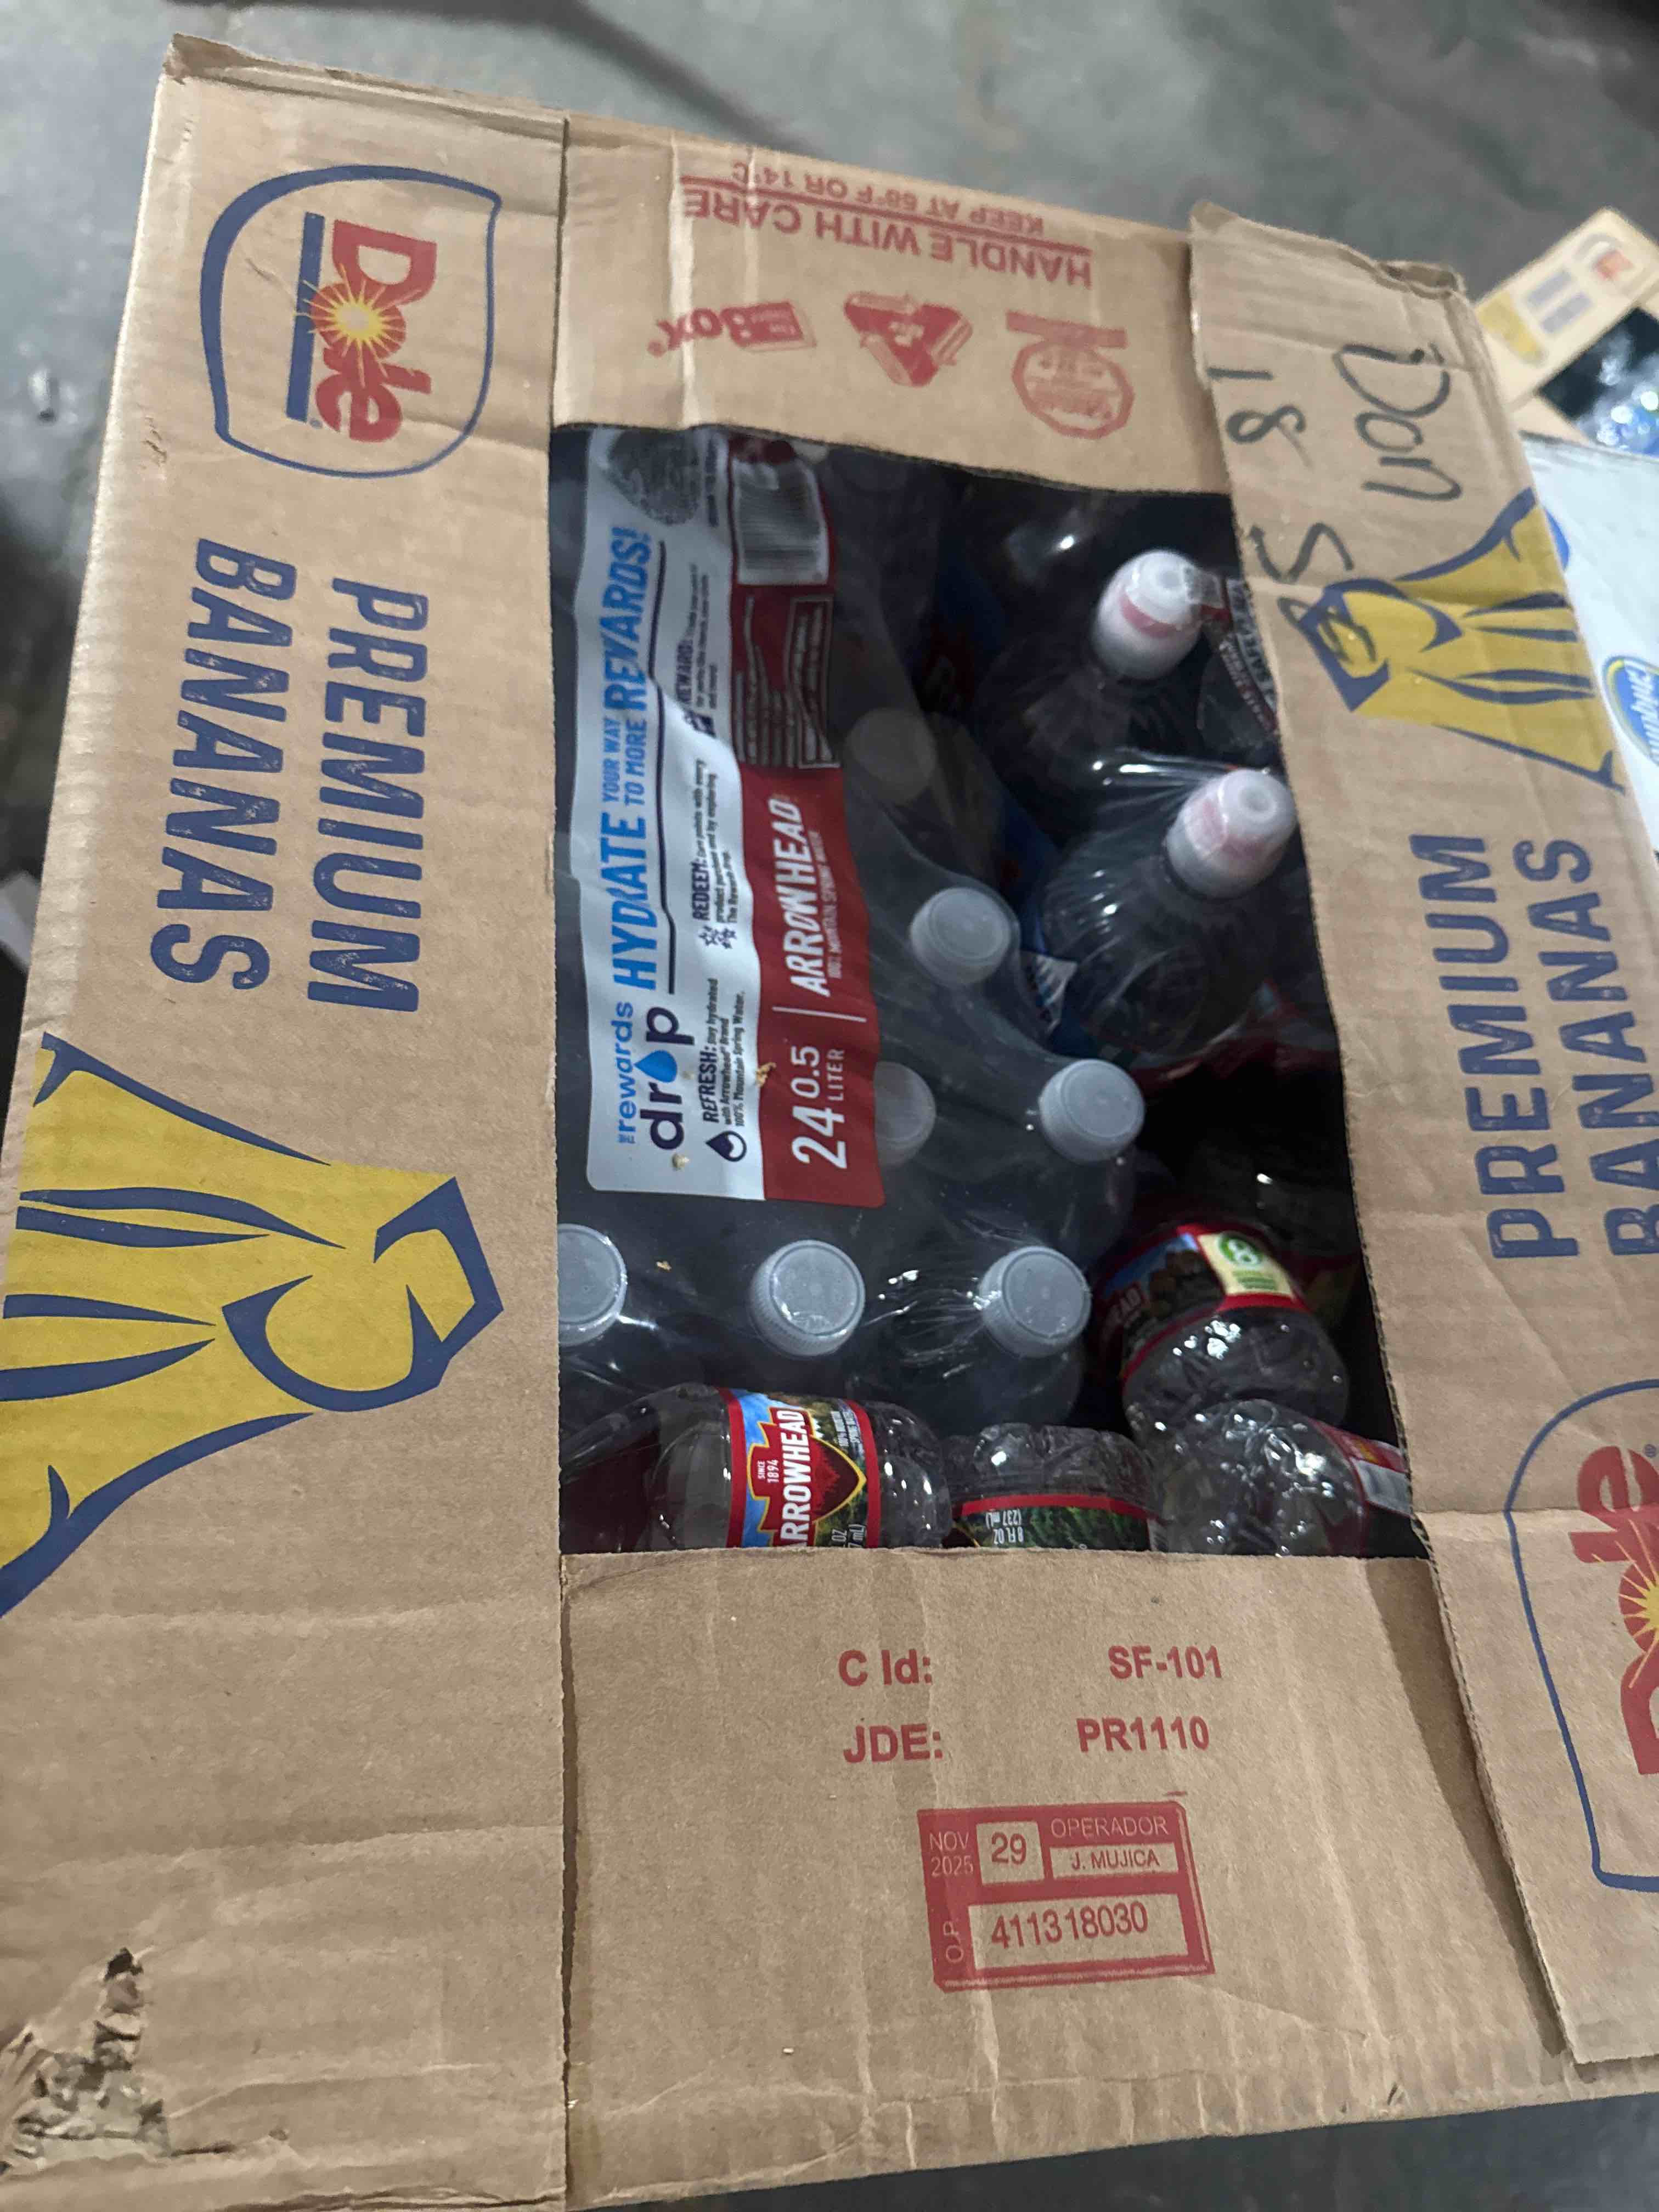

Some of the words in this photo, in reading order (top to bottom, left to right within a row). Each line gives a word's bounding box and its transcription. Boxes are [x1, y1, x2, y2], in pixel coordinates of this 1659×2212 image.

[803, 173, 848, 198] OR
[684, 189, 802, 234] CARE
[926, 195, 960, 219] AT
[816, 211, 921, 256] WITH
[928, 230, 1092, 290] HANDLE
[314, 219, 438, 443] Dole
[603, 716, 621, 753] WAY
[625, 719, 647, 777] MORE
[150, 538, 297, 990] BANANAS
[603, 758, 620, 802] YOUR
[307, 578, 429, 1012] PREMIUM
[624, 782, 645, 806] TO
[691, 857, 710, 921] REDEEM:
[768, 798, 831, 997] ARROWHEAD
[706, 978, 719, 1024] hydrated
[733, 1027, 746, 1056] Spring
[1408, 833, 1579, 1259] PREMIUM
[1512, 838, 1659, 1256] BANANAS
[611, 1001, 637, 1132] rewards
[640, 1007, 695, 1150] drop
[698, 1045, 719, 1123] REFRESH:
[733, 1057, 745, 1100] Mountain
[790, 1045, 821, 1099] 0.5
[827, 1048, 845, 1101] LITER
[721, 1106, 732, 1125] with
[733, 1102, 745, 1126] 100%
[791, 1105, 847, 1169] 24
[757, 1460, 766, 1480] SINCE
[766, 1459, 779, 1483] 1894
[831, 1529, 848, 1542] OZ
[848, 1523, 867, 1541] mL)
[993, 1528, 1005, 1545] OZ
[838, 1650, 868, 1686] C
[881, 1649, 932, 1685] Id:
[1108, 1645, 1222, 1680] SF-101
[843, 1723, 943, 1763] JDE:
[1076, 1716, 1210, 1753] PR1110
[929, 1830, 970, 1852] NOV
[1050, 1816, 1170, 1839] OPERADOR
[931, 1854, 974, 1877] 2025
[991, 1832, 1027, 1865] 29
[1070, 1852, 1087, 1871] J.
[1091, 1848, 1160, 1869] MUJICA
[991, 1901, 1149, 1949] 411318030
